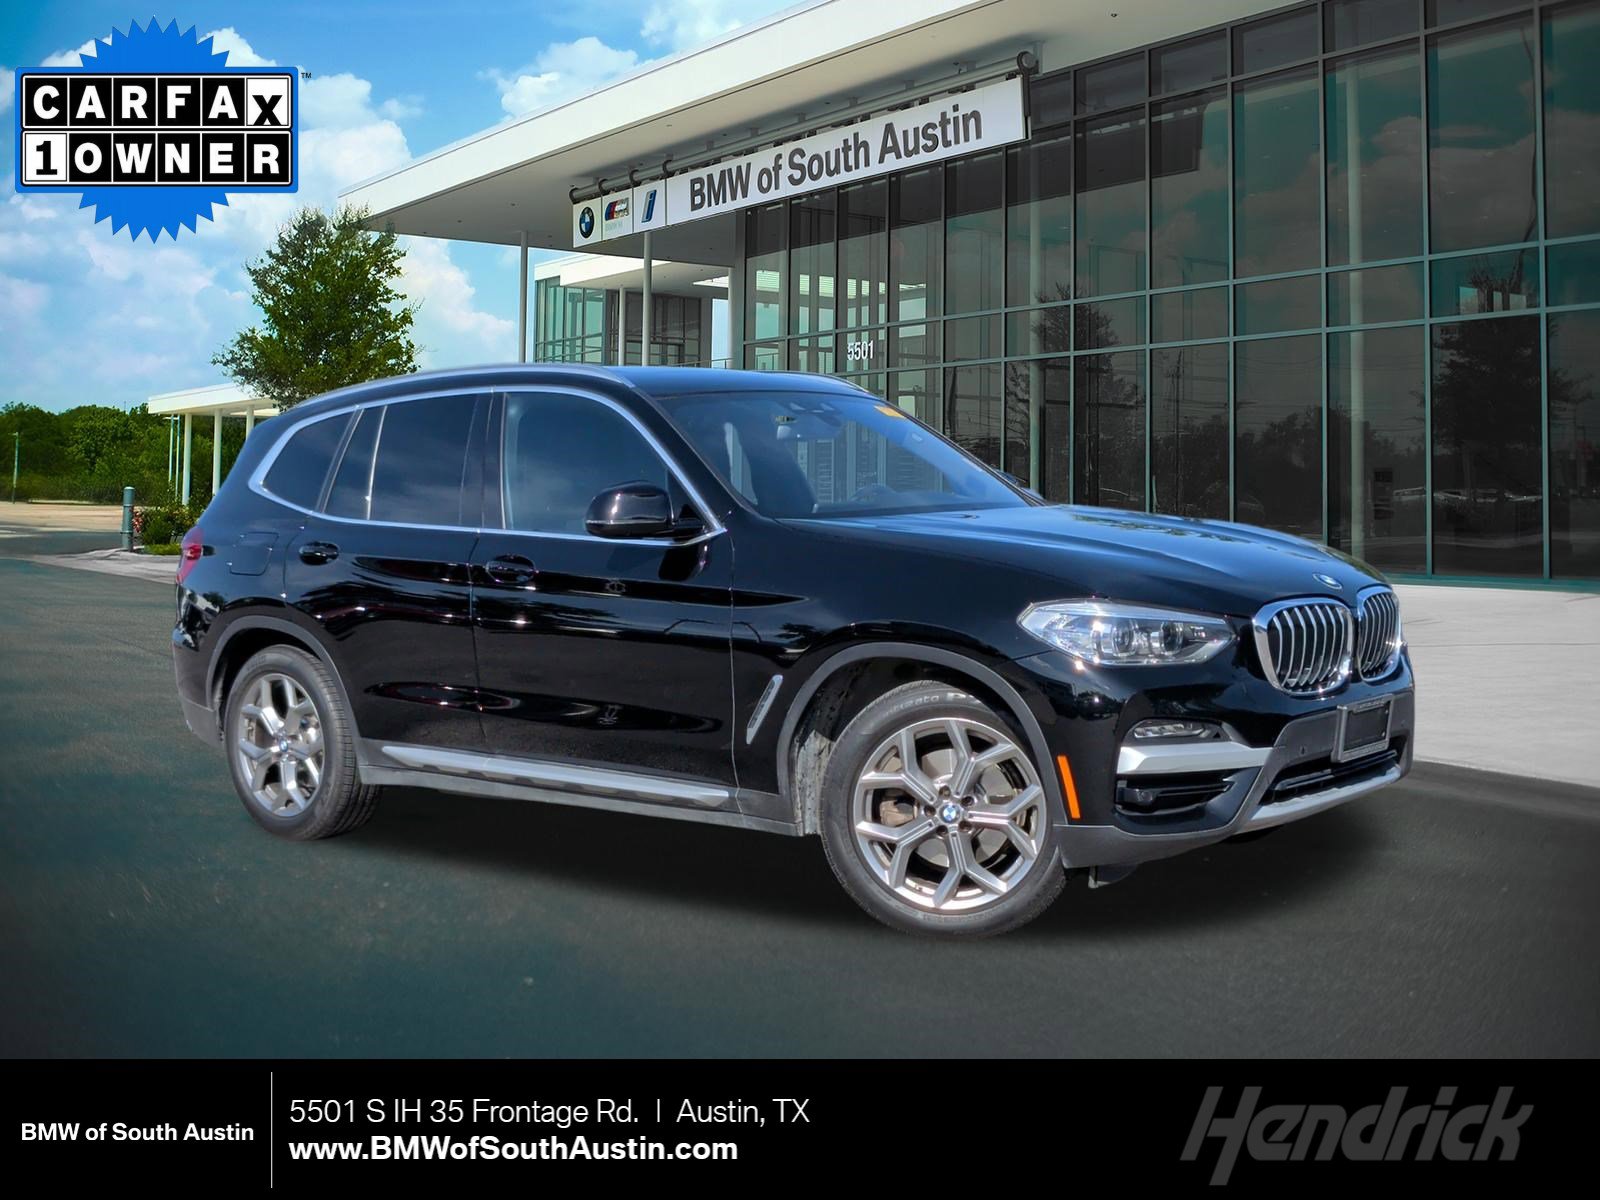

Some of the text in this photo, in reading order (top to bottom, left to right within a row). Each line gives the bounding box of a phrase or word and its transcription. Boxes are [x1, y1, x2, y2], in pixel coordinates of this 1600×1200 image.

[690, 104, 982, 212] BMW of South Austin
[847, 340, 874, 361] 5501
